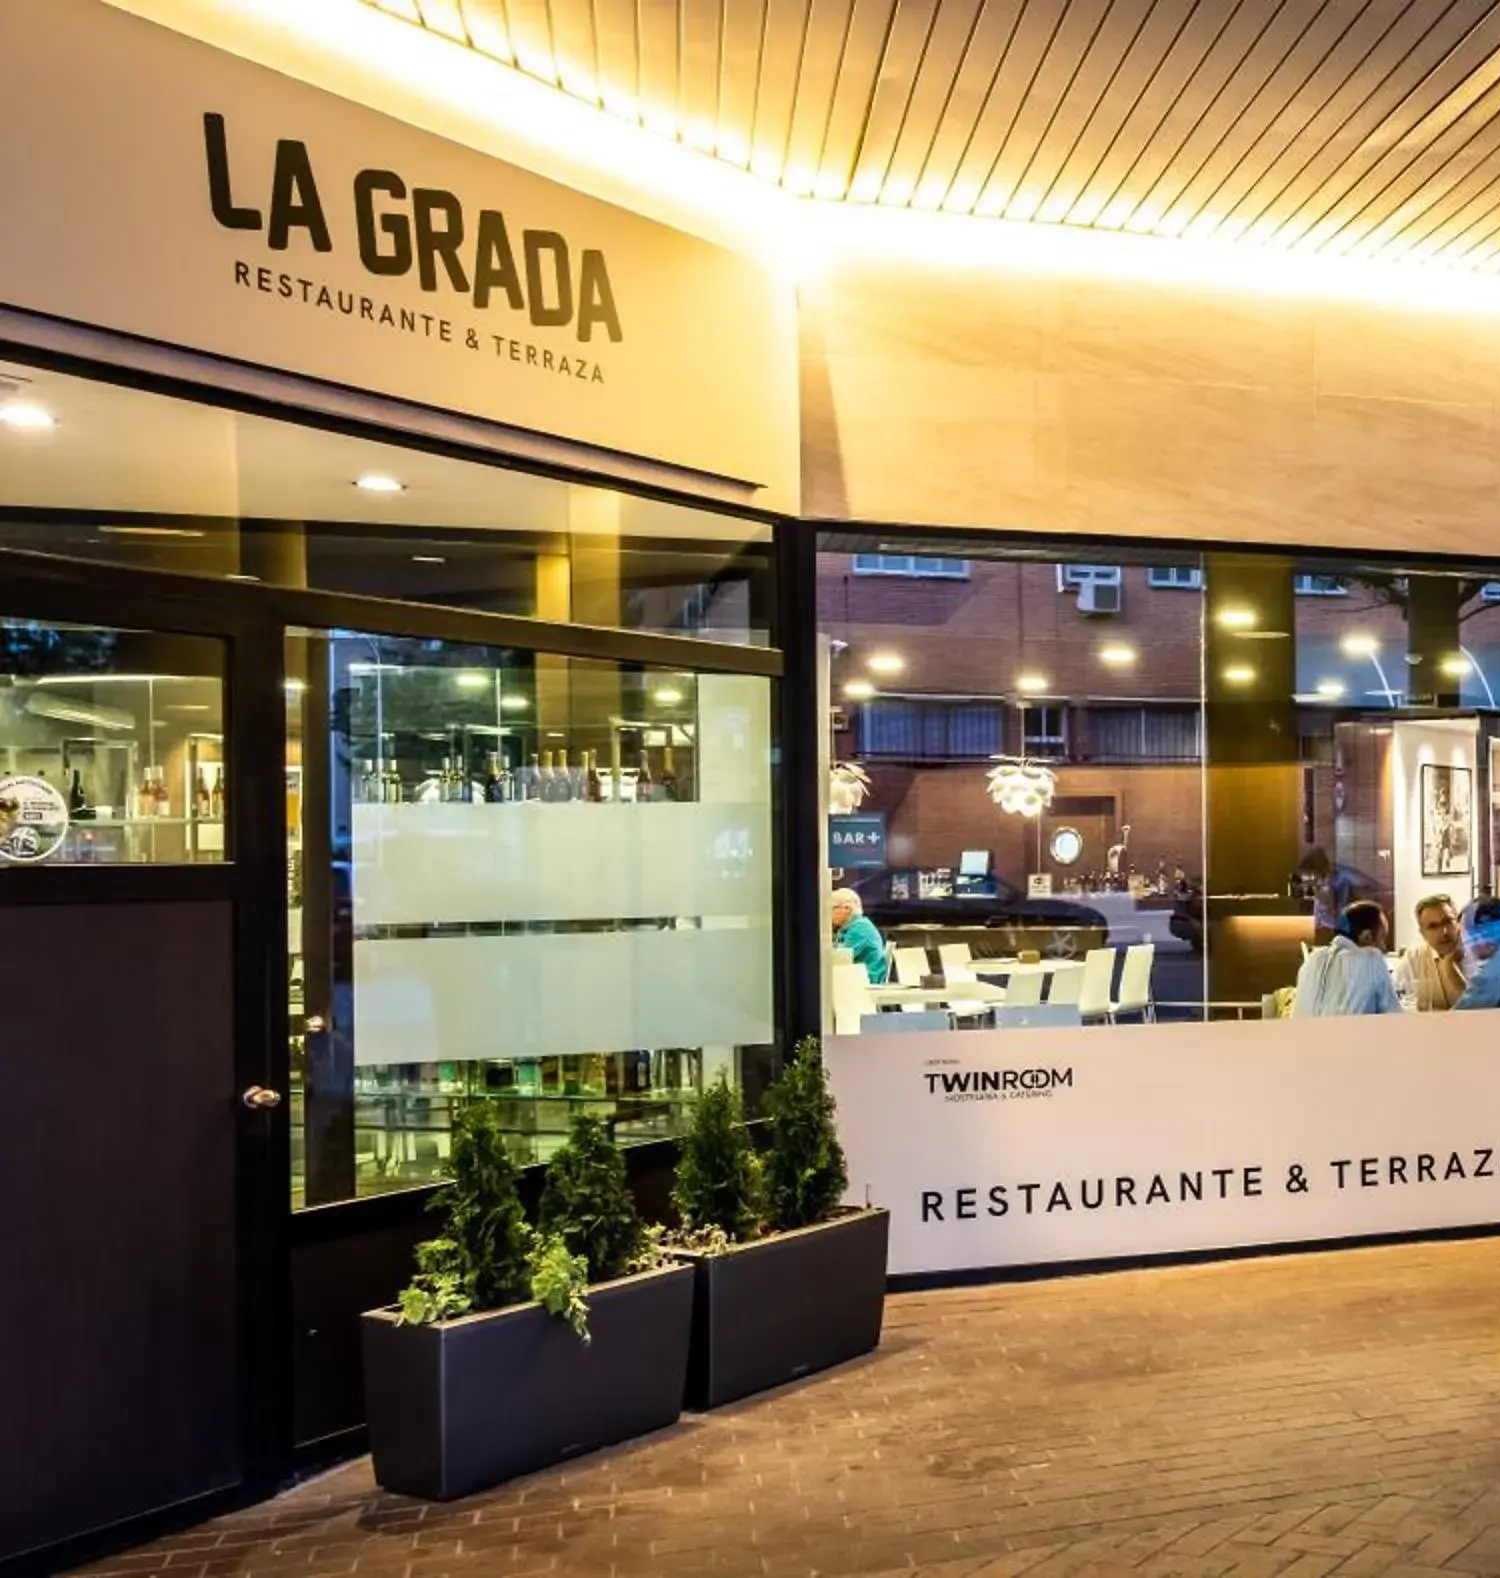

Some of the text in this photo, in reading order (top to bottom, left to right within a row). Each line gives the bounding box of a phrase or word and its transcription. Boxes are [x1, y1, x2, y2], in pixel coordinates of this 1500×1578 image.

[203, 111, 623, 343] LA GRADA
[235, 261, 604, 384] RESTAURANTE & TERRAZA
[924, 1067, 1073, 1093] TWINROOM
[921, 1167, 1262, 1222] RESTAURANTE
[1286, 1164, 1309, 1193] &
